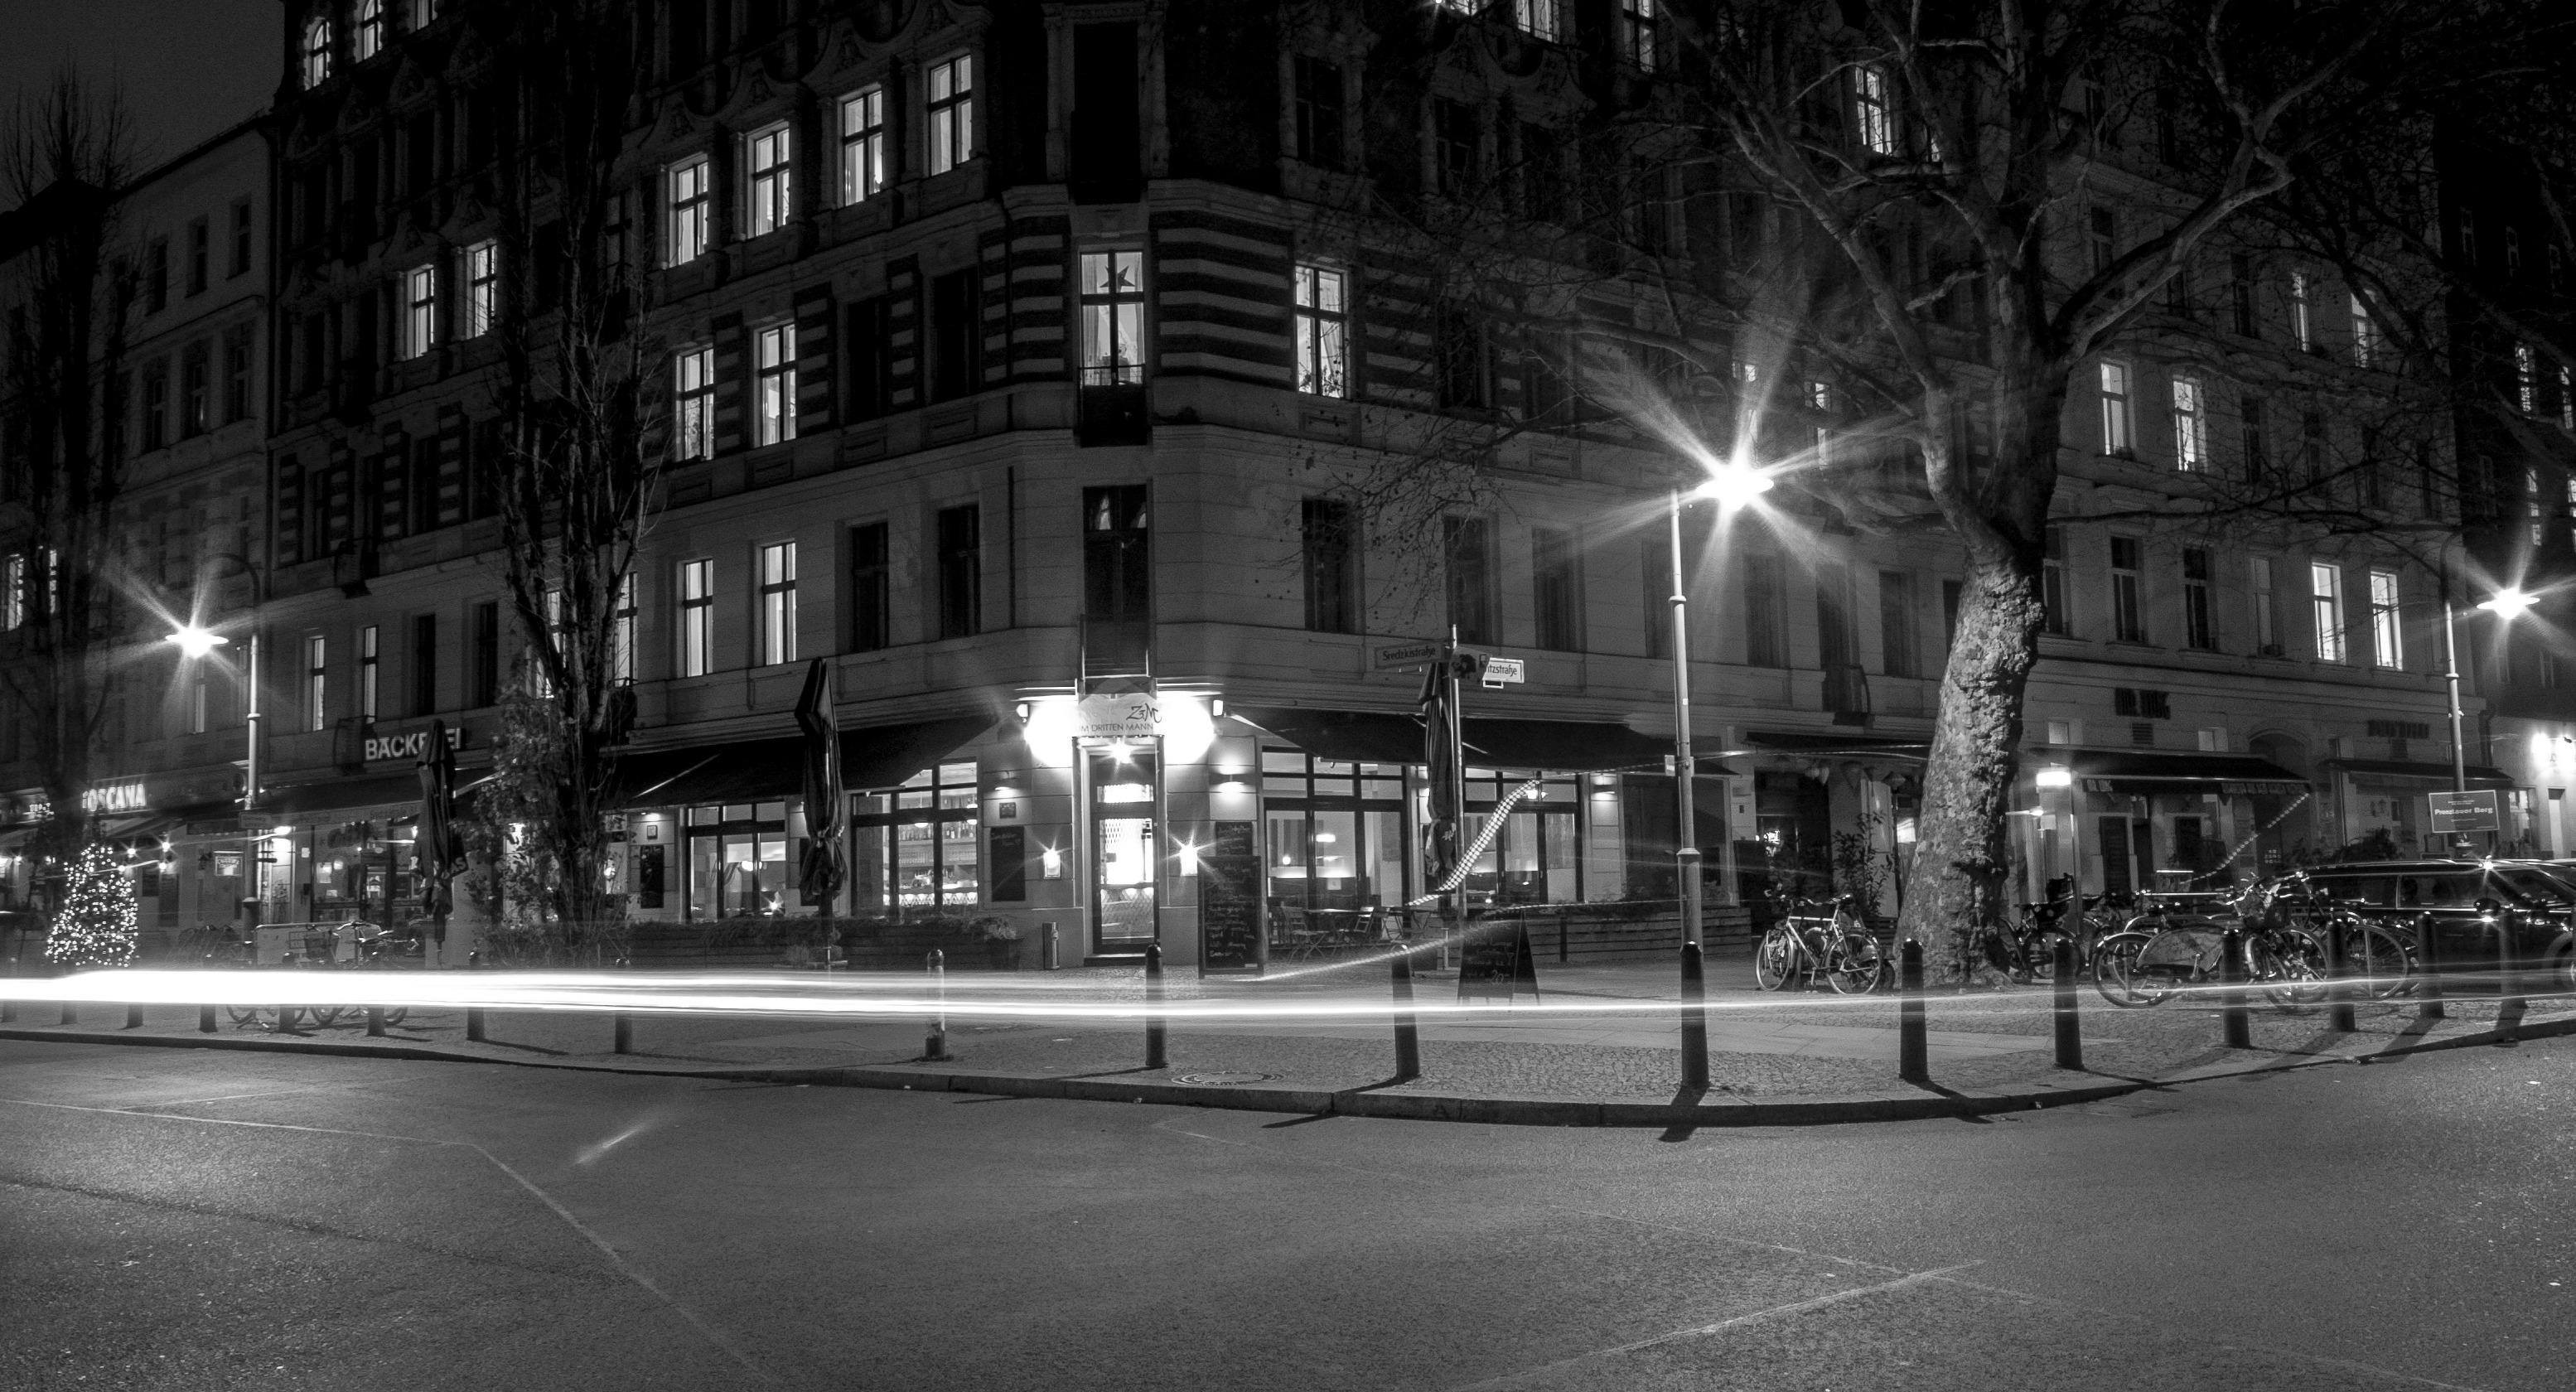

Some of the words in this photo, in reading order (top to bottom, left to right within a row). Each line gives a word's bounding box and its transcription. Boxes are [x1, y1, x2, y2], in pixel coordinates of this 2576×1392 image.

[1487, 664, 1518, 678] itzstraße
[1091, 723, 1124, 732] DRITTEN
[1126, 723, 1153, 731] MANN
[365, 727, 461, 761] BÄCKEEI
